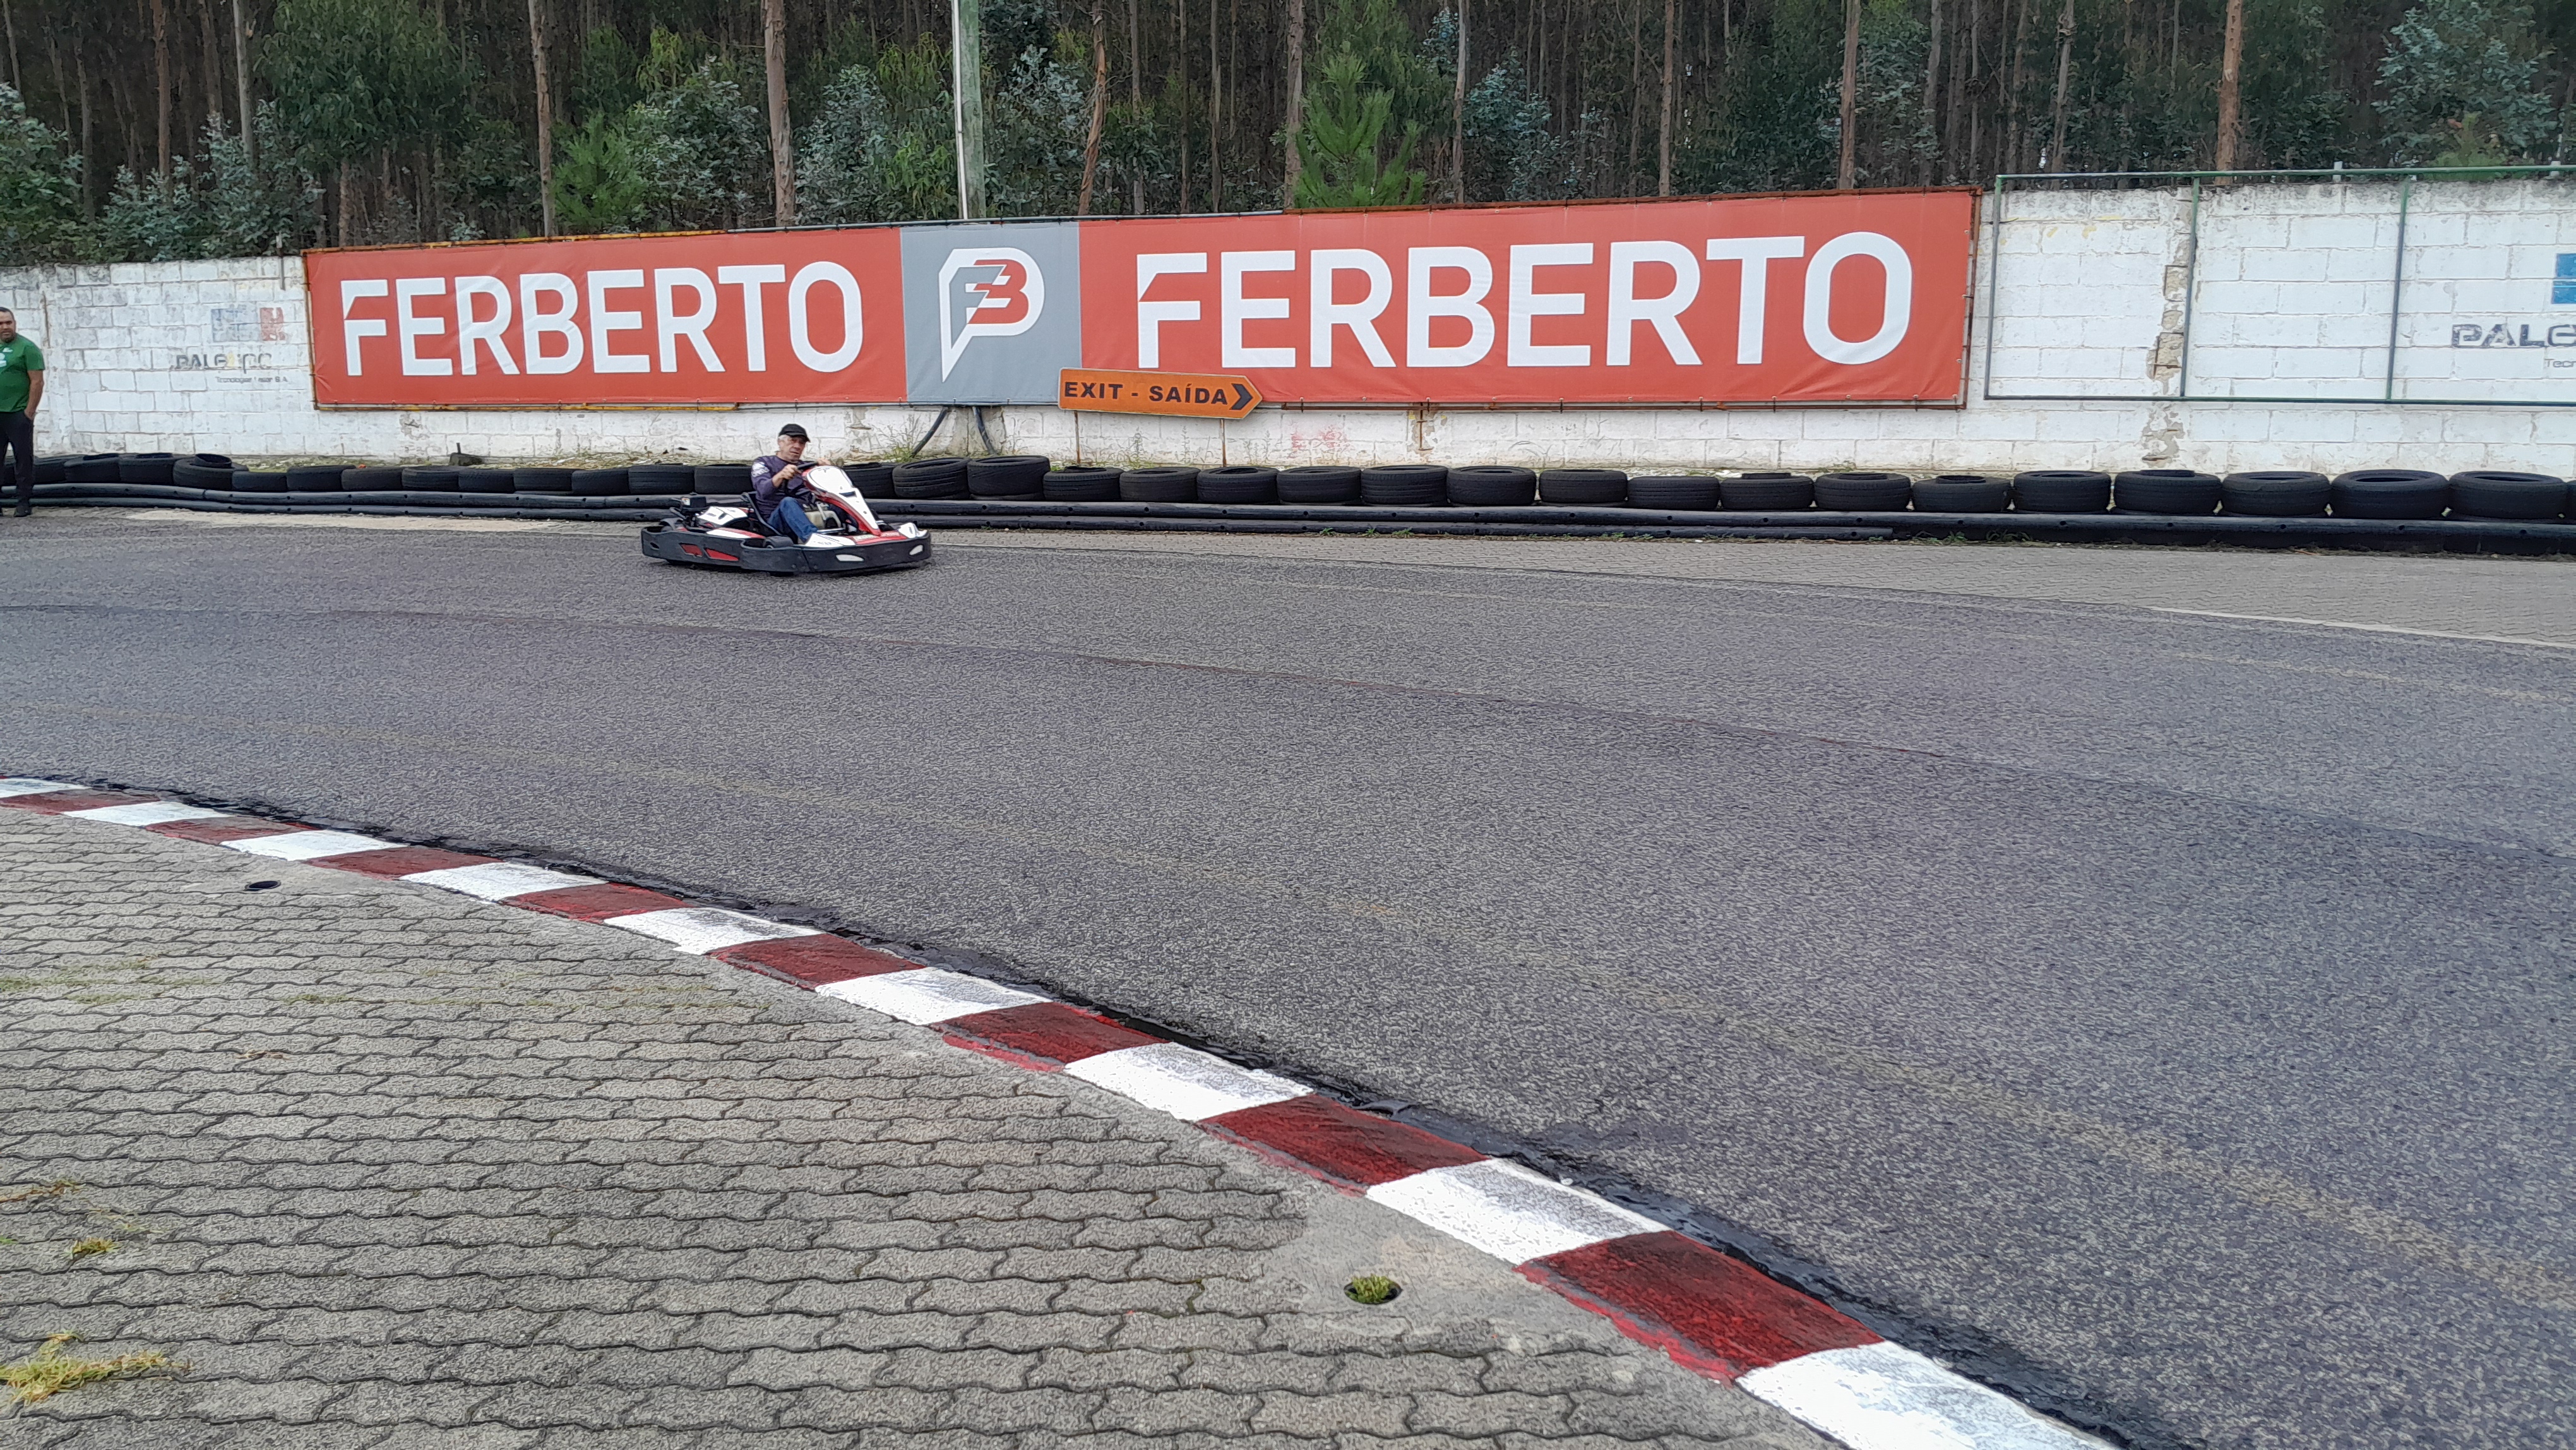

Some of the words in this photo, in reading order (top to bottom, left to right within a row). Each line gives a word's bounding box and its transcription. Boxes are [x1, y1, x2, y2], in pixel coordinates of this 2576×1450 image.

[340, 260, 864, 376] FERBERTO
[1136, 231, 1914, 369] FERBERTO
[1064, 381, 1123, 400] EXIT
[1149, 383, 1228, 405] SAÍDA
